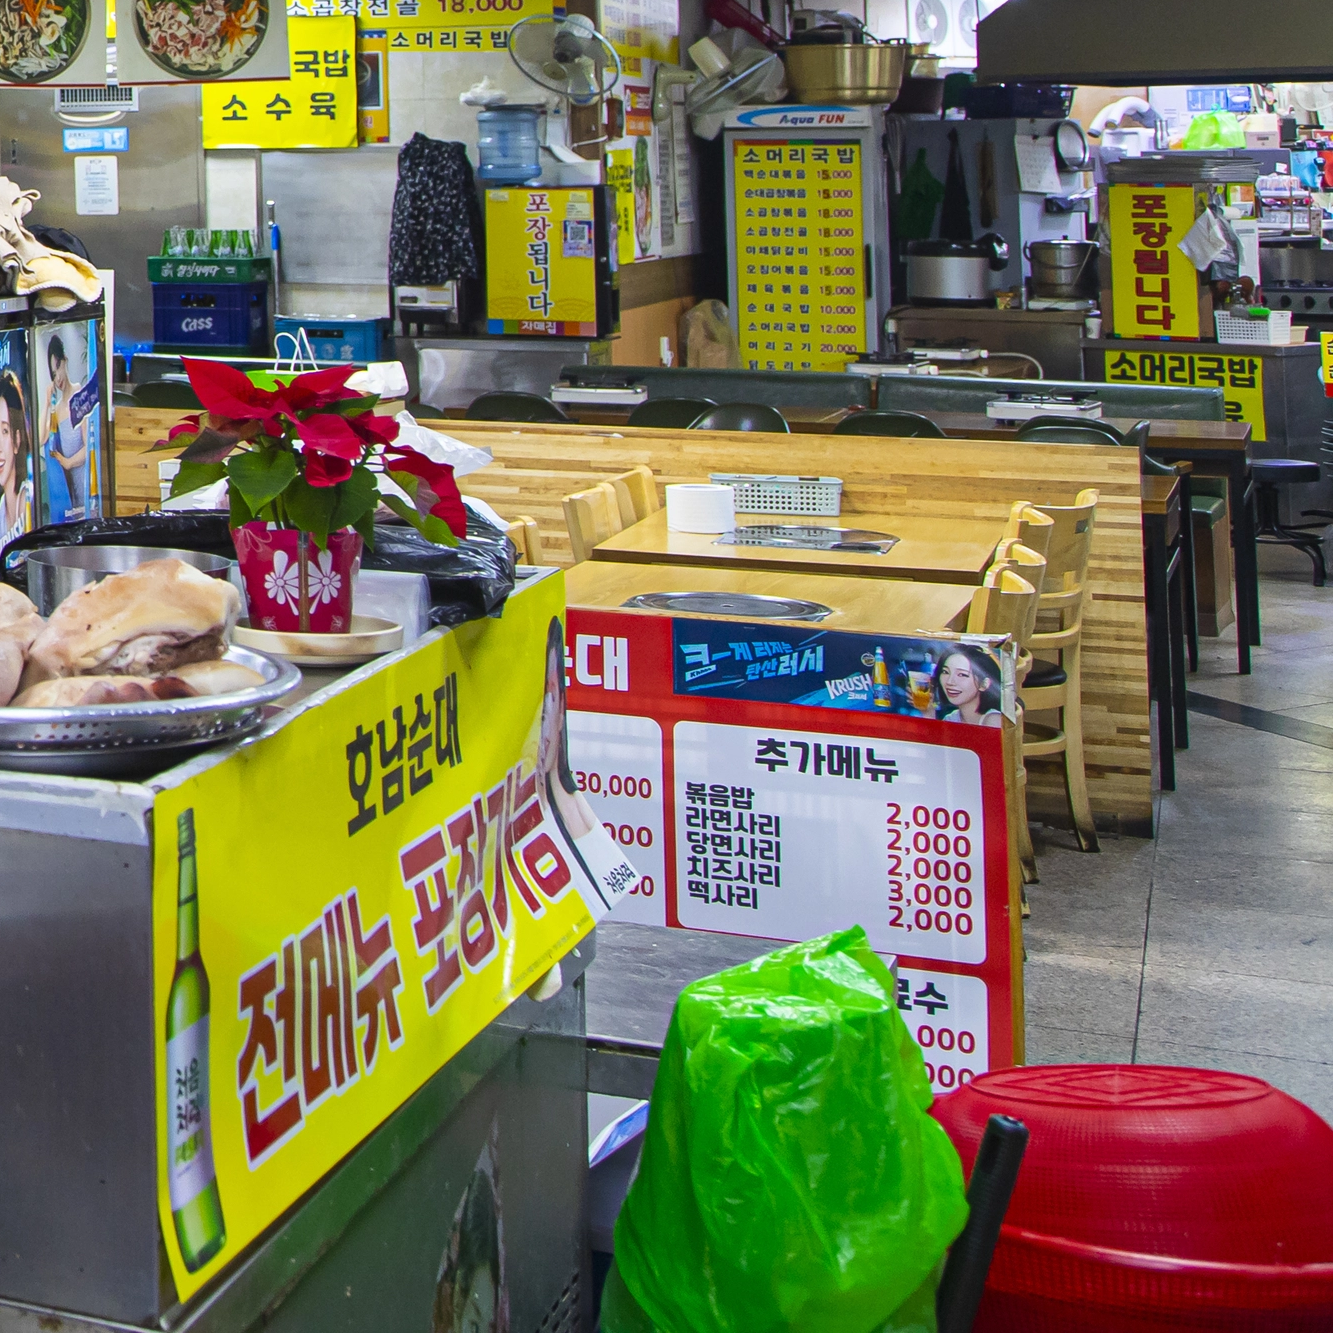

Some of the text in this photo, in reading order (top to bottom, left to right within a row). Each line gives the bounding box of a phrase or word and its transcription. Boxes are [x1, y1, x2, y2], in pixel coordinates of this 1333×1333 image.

[390, 30, 509, 49] 소머리국밥
[293, 49, 350, 79] 국밥
[221, 91, 337, 123] 소수육
[818, 114, 845, 124] FUN
[742, 146, 856, 165] 소머리국밥
[525, 192, 554, 318] 포장됩니다
[181, 316, 213, 333] Cass
[747, 303, 810, 314] 순대국밥
[747, 322, 810, 334] 소머리국밥
[747, 341, 811, 353] 머리고기
[1110, 351, 1259, 389] 소머리국밥
[564, 633, 630, 693] 대
[825, 672, 872, 700] KRUSH
[346, 671, 463, 837] 호남순대
[755, 736, 900, 784] 추가메뉴
[685, 780, 972, 833] 볶음밥 2,000
[685, 805, 973, 860] 라면사리 2,000
[686, 831, 974, 885] 당면사리 2,000
[686, 855, 782, 889] 치즈사리
[888, 881, 974, 911] 3,000
[689, 880, 760, 910] 떡사리
[889, 906, 974, 937] 2,000
[236, 763, 572, 1171] 전메뉴 포장가능
